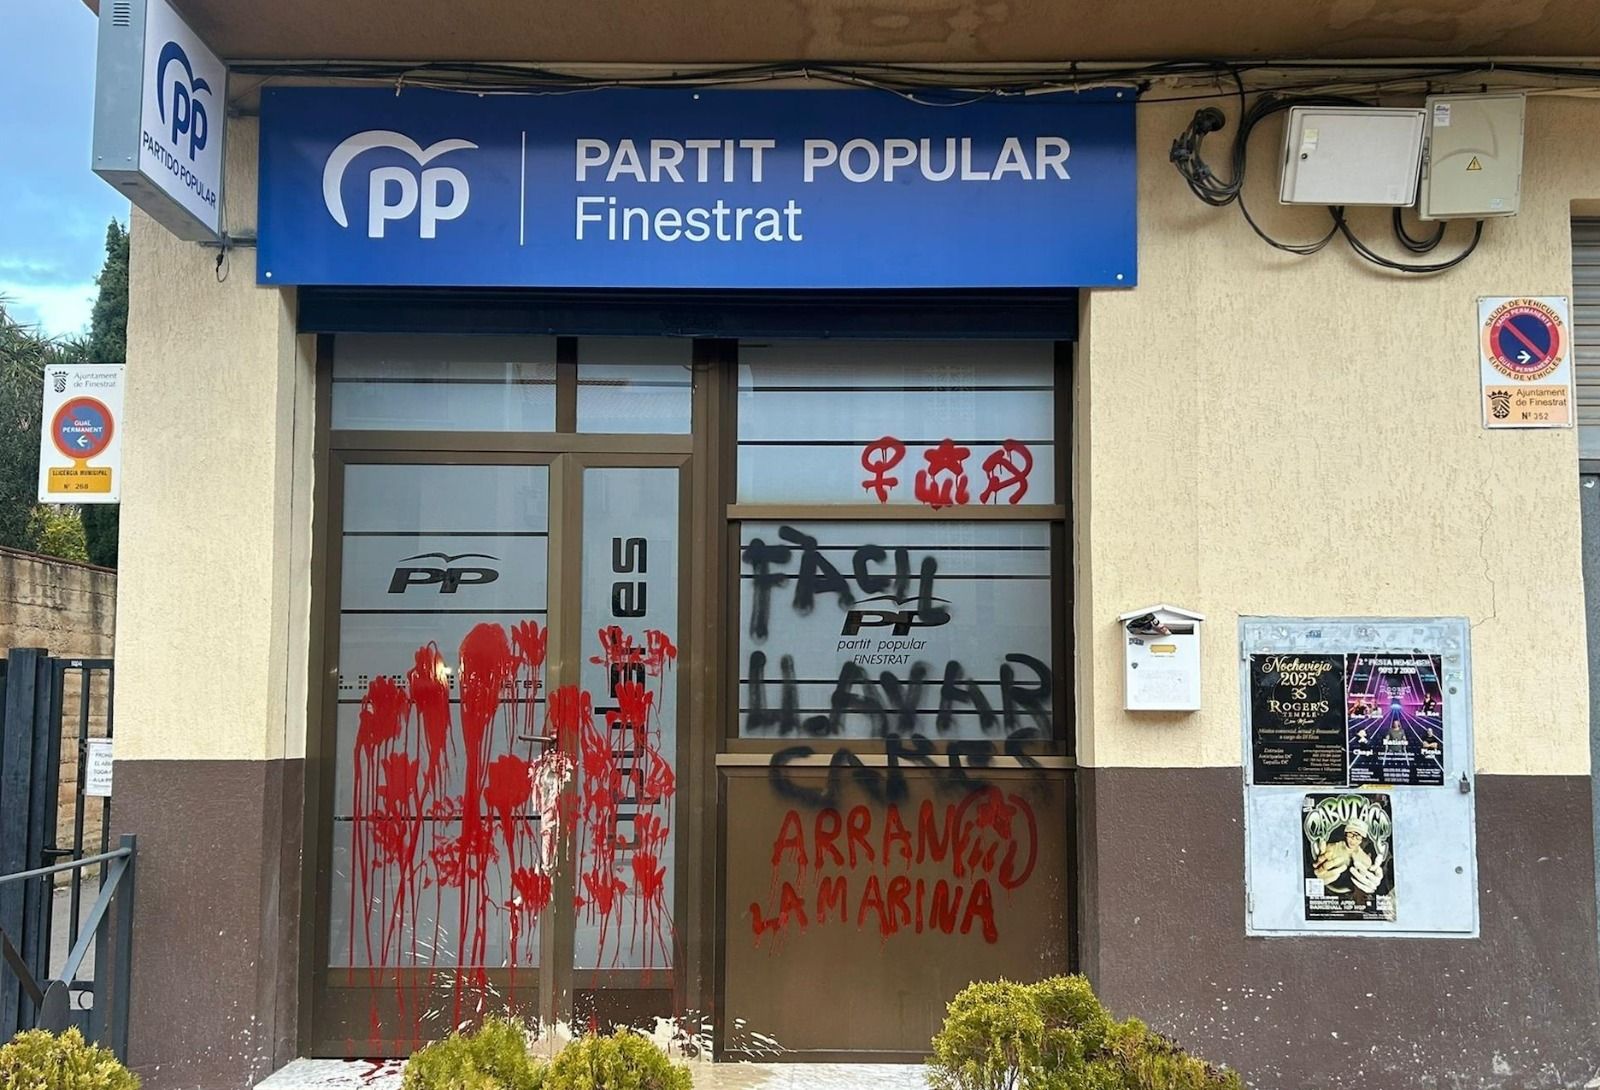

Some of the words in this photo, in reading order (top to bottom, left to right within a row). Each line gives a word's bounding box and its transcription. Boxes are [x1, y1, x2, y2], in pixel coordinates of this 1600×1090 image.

[575, 138, 776, 183] PARTIT
[803, 136, 1071, 183] POPULAR
[143, 131, 179, 176] PARTIDO
[180, 164, 216, 209] POPULAR
[575, 196, 803, 242] Finestrat
[1485, 304, 1507, 327] SALIDA
[1508, 299, 1519, 307] DE
[1522, 299, 1563, 327] VEHICULOS
[1489, 355, 1511, 378] EIXIDA
[1526, 357, 1562, 381] VEHICLES
[1498, 355, 1513, 370] GUAL
[1515, 355, 1553, 372] PERMANENT
[74, 372, 117, 381] Ajuntament
[1515, 398, 1527, 406] de
[1529, 398, 1567, 406] Finestrat
[1516, 388, 1565, 398] Ajuntament
[837, 638, 871, 652] partit
[877, 638, 927, 652] popular
[853, 654, 910, 665] FINESTRAT
[1261, 656, 1332, 676] Nochevieja
[1280, 672, 1316, 686] 2025
[1267, 700, 1329, 713] ROGER'S
[771, 800, 956, 868] ARRAN
[750, 882, 808, 935] LA
[816, 875, 998, 944] MARINA
